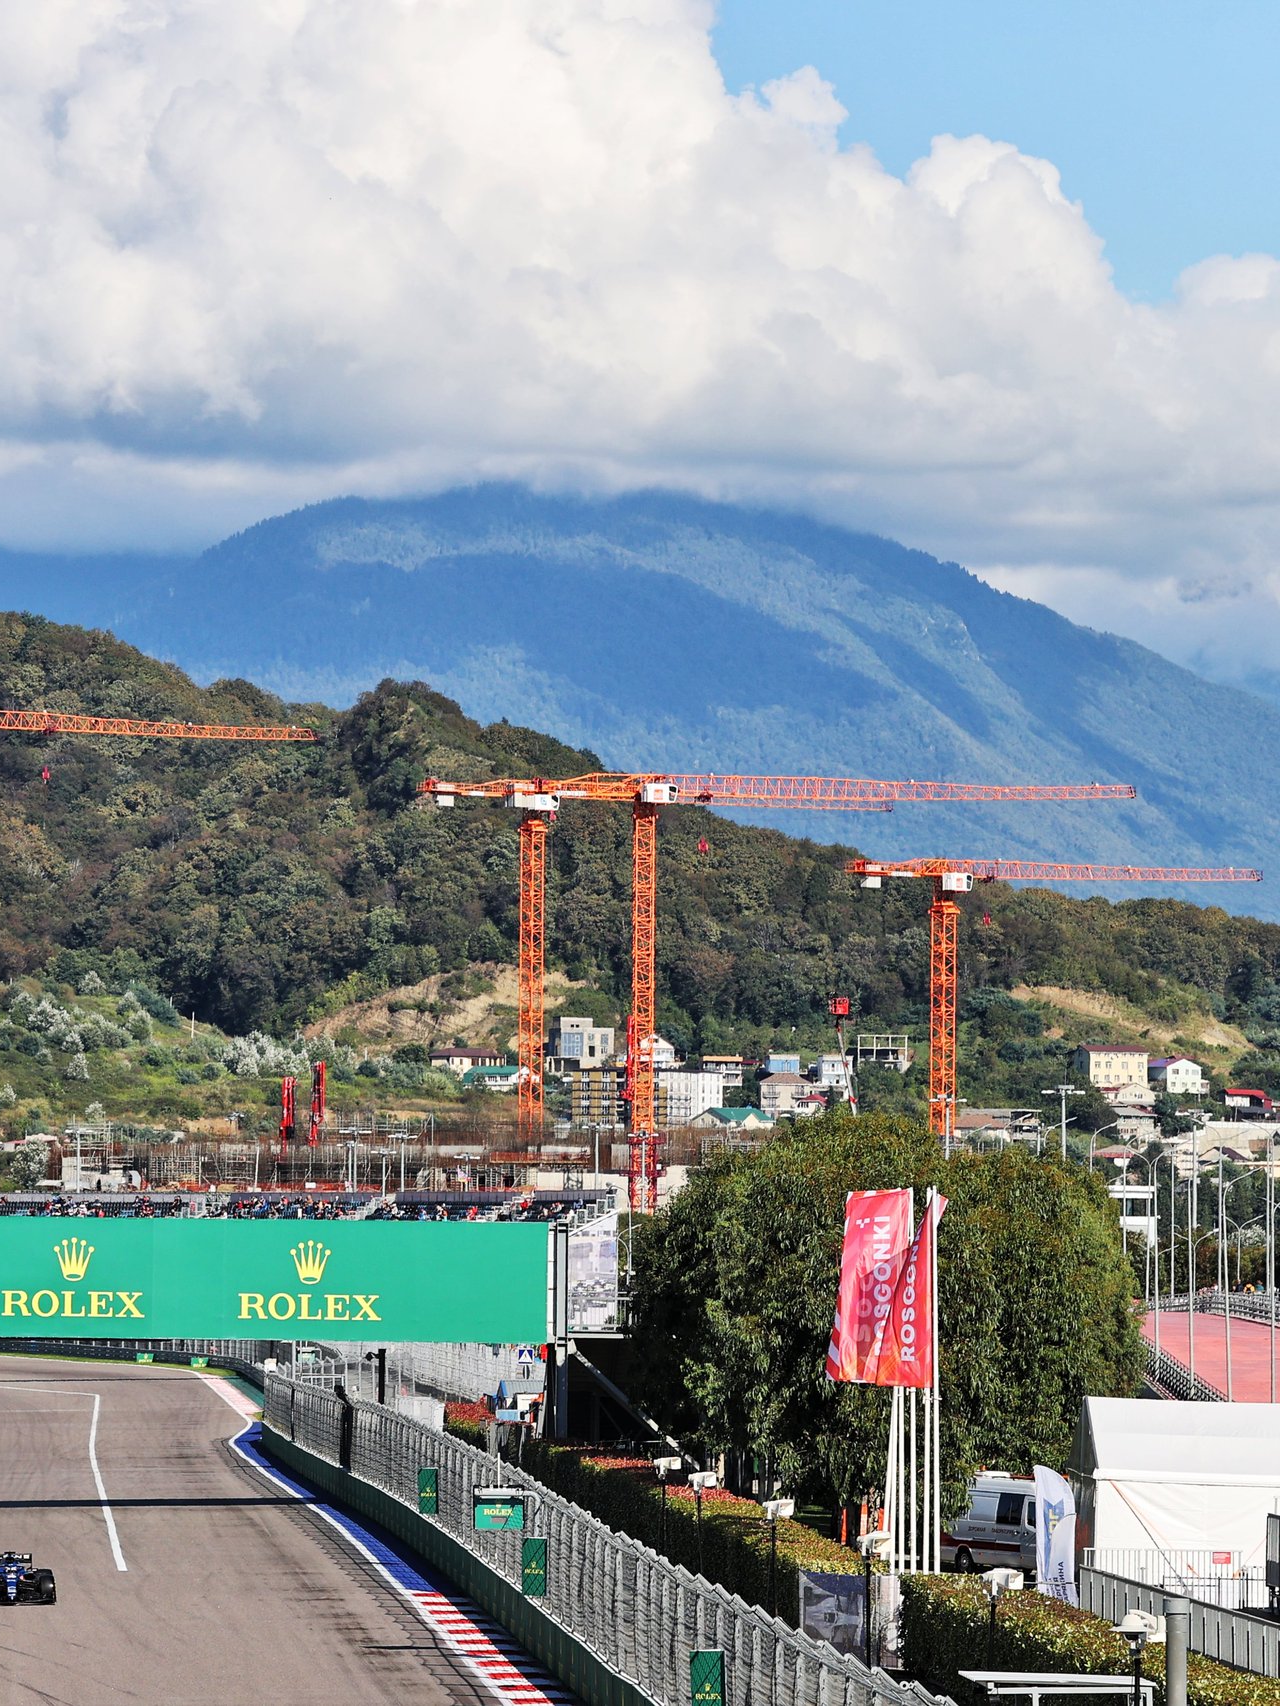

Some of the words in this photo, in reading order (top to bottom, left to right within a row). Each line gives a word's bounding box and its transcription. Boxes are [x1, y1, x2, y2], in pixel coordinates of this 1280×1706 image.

[1, 1289, 146, 1318] ROLEX
[237, 1292, 382, 1321] ROLEX
[483, 1507, 513, 1517] ROLEX
